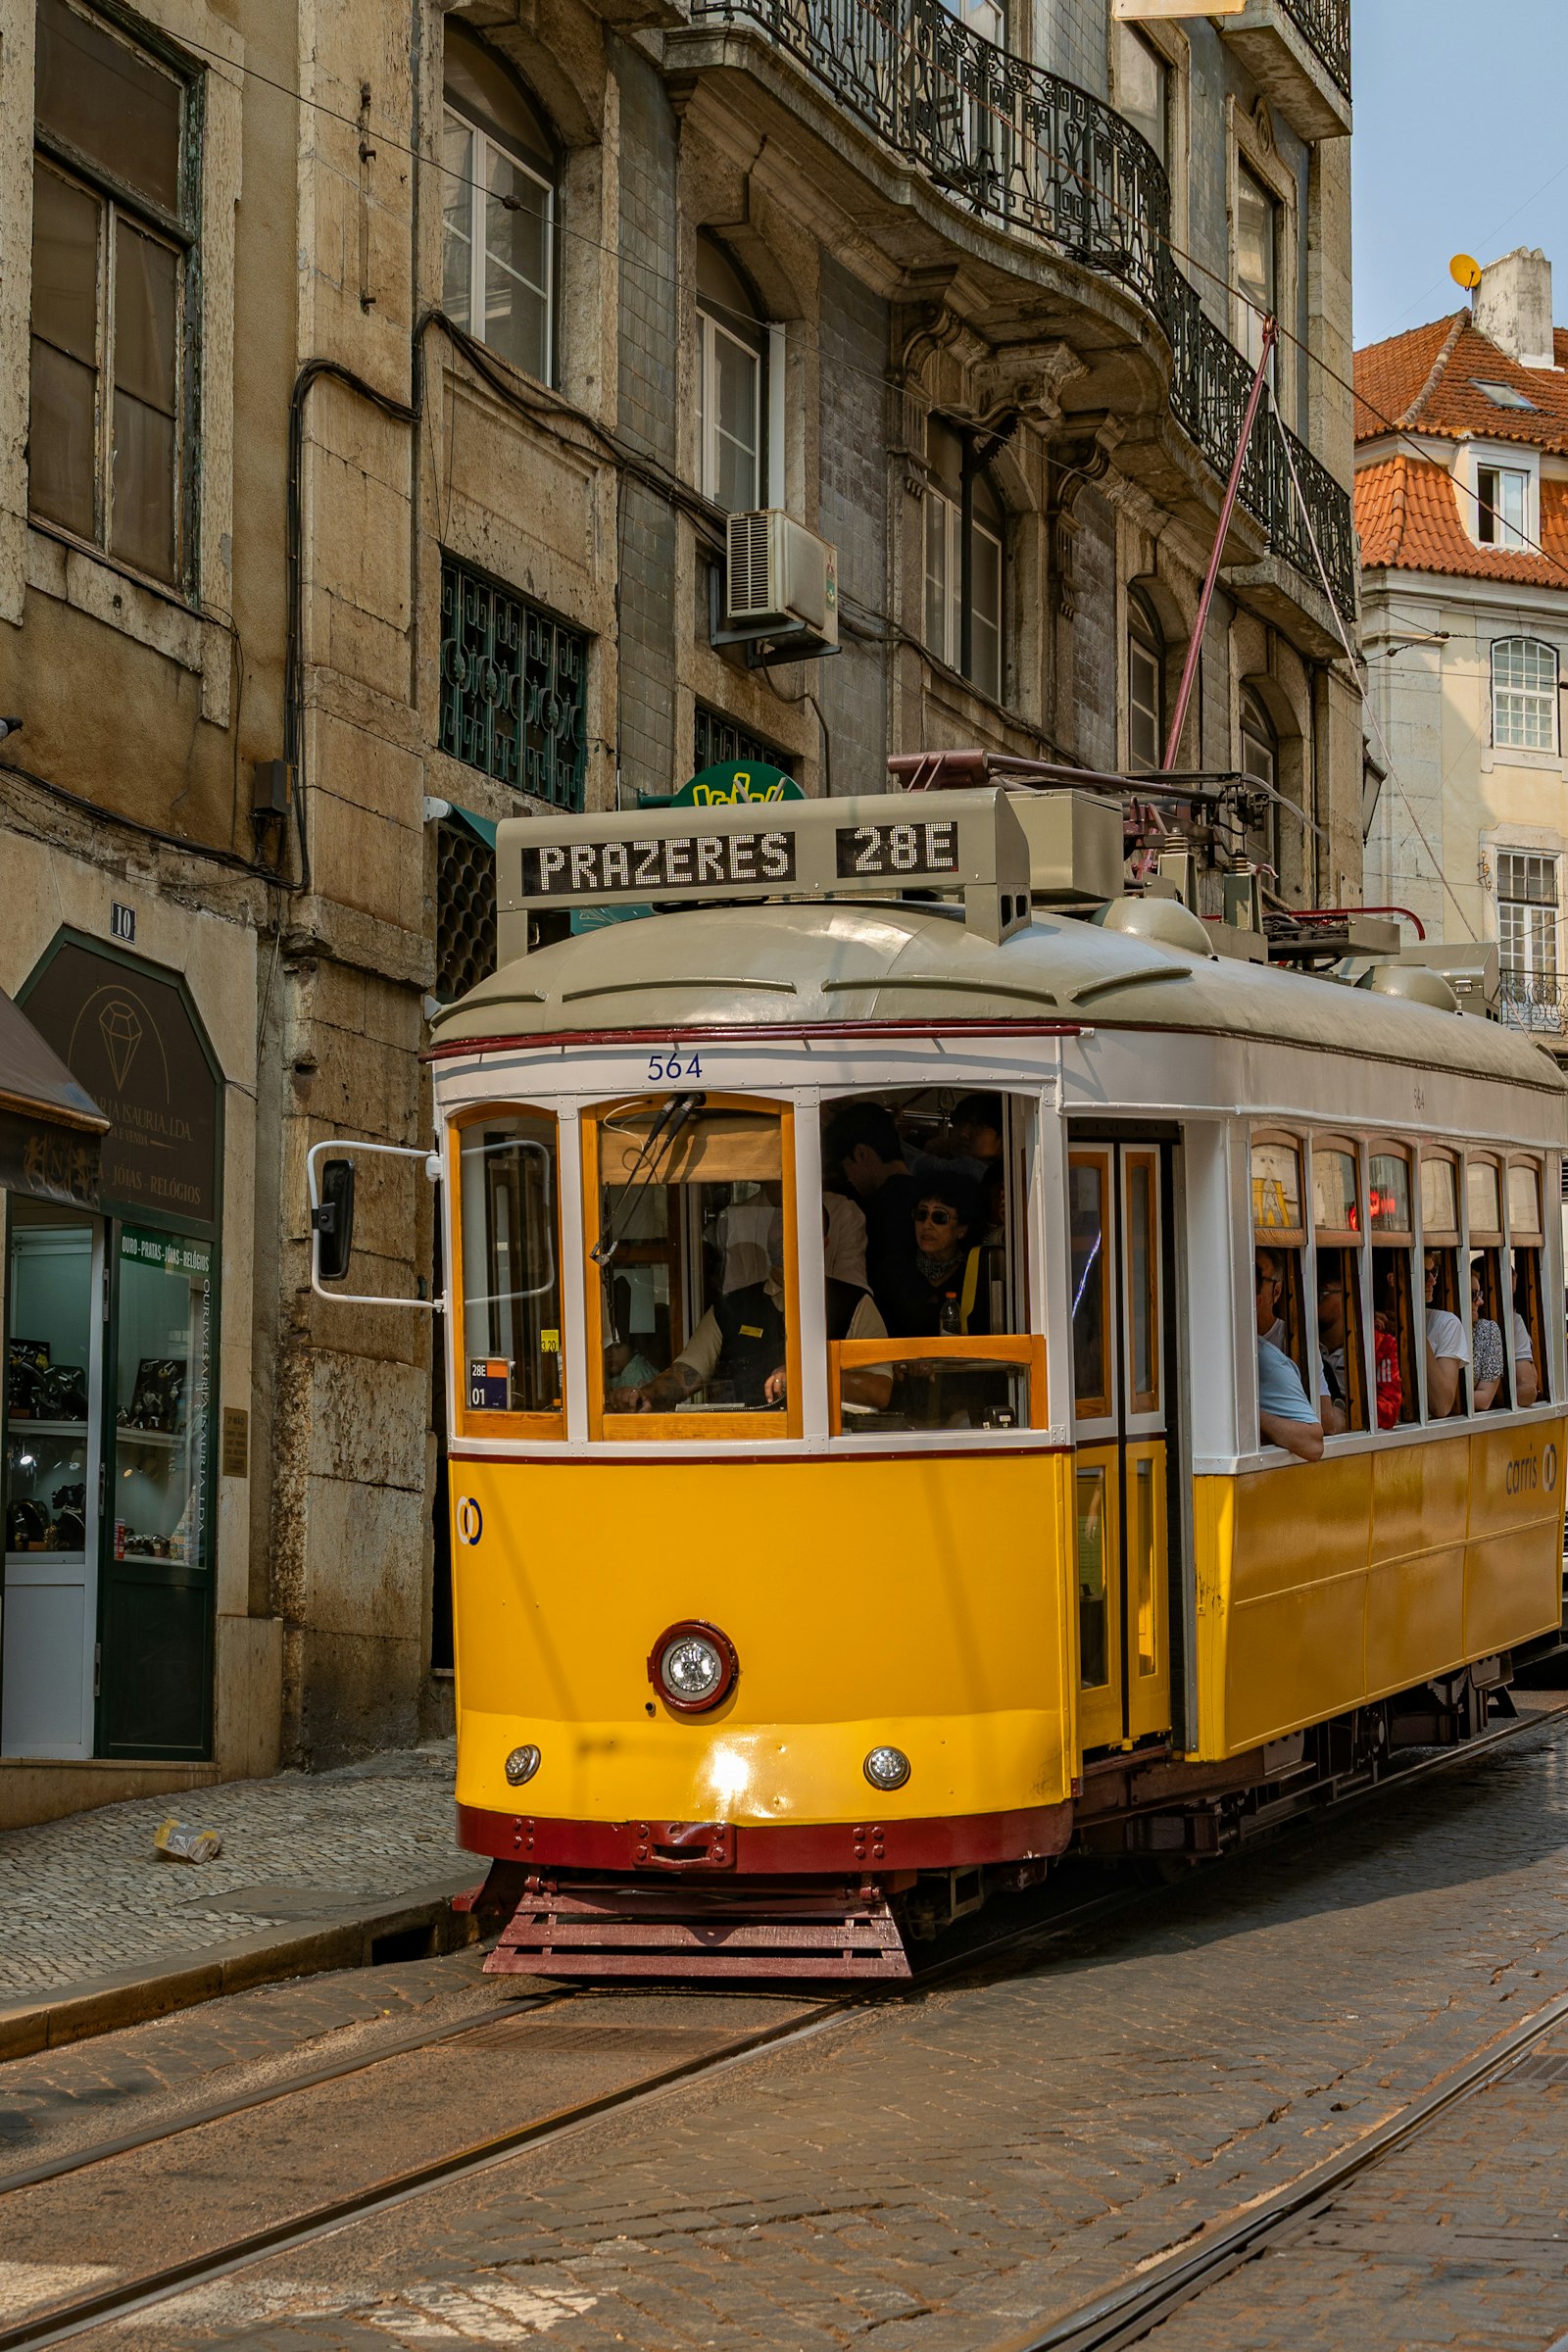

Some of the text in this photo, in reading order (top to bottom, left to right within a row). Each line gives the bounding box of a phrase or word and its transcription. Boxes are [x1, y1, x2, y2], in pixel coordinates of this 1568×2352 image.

[539, 822, 954, 891] PRAZERES 28E
[117, 906, 131, 938] 10
[648, 1053, 703, 1081] 564
[1413, 1088, 1425, 1109] 564
[124, 1130, 149, 1147] VENDA
[112, 1163, 142, 1190] JÓIAS
[150, 1175, 201, 1205] RELÓGIOS
[471, 1364, 486, 1377] 28E
[471, 1388, 485, 1405] 01
[1506, 1443, 1538, 1495] carris
